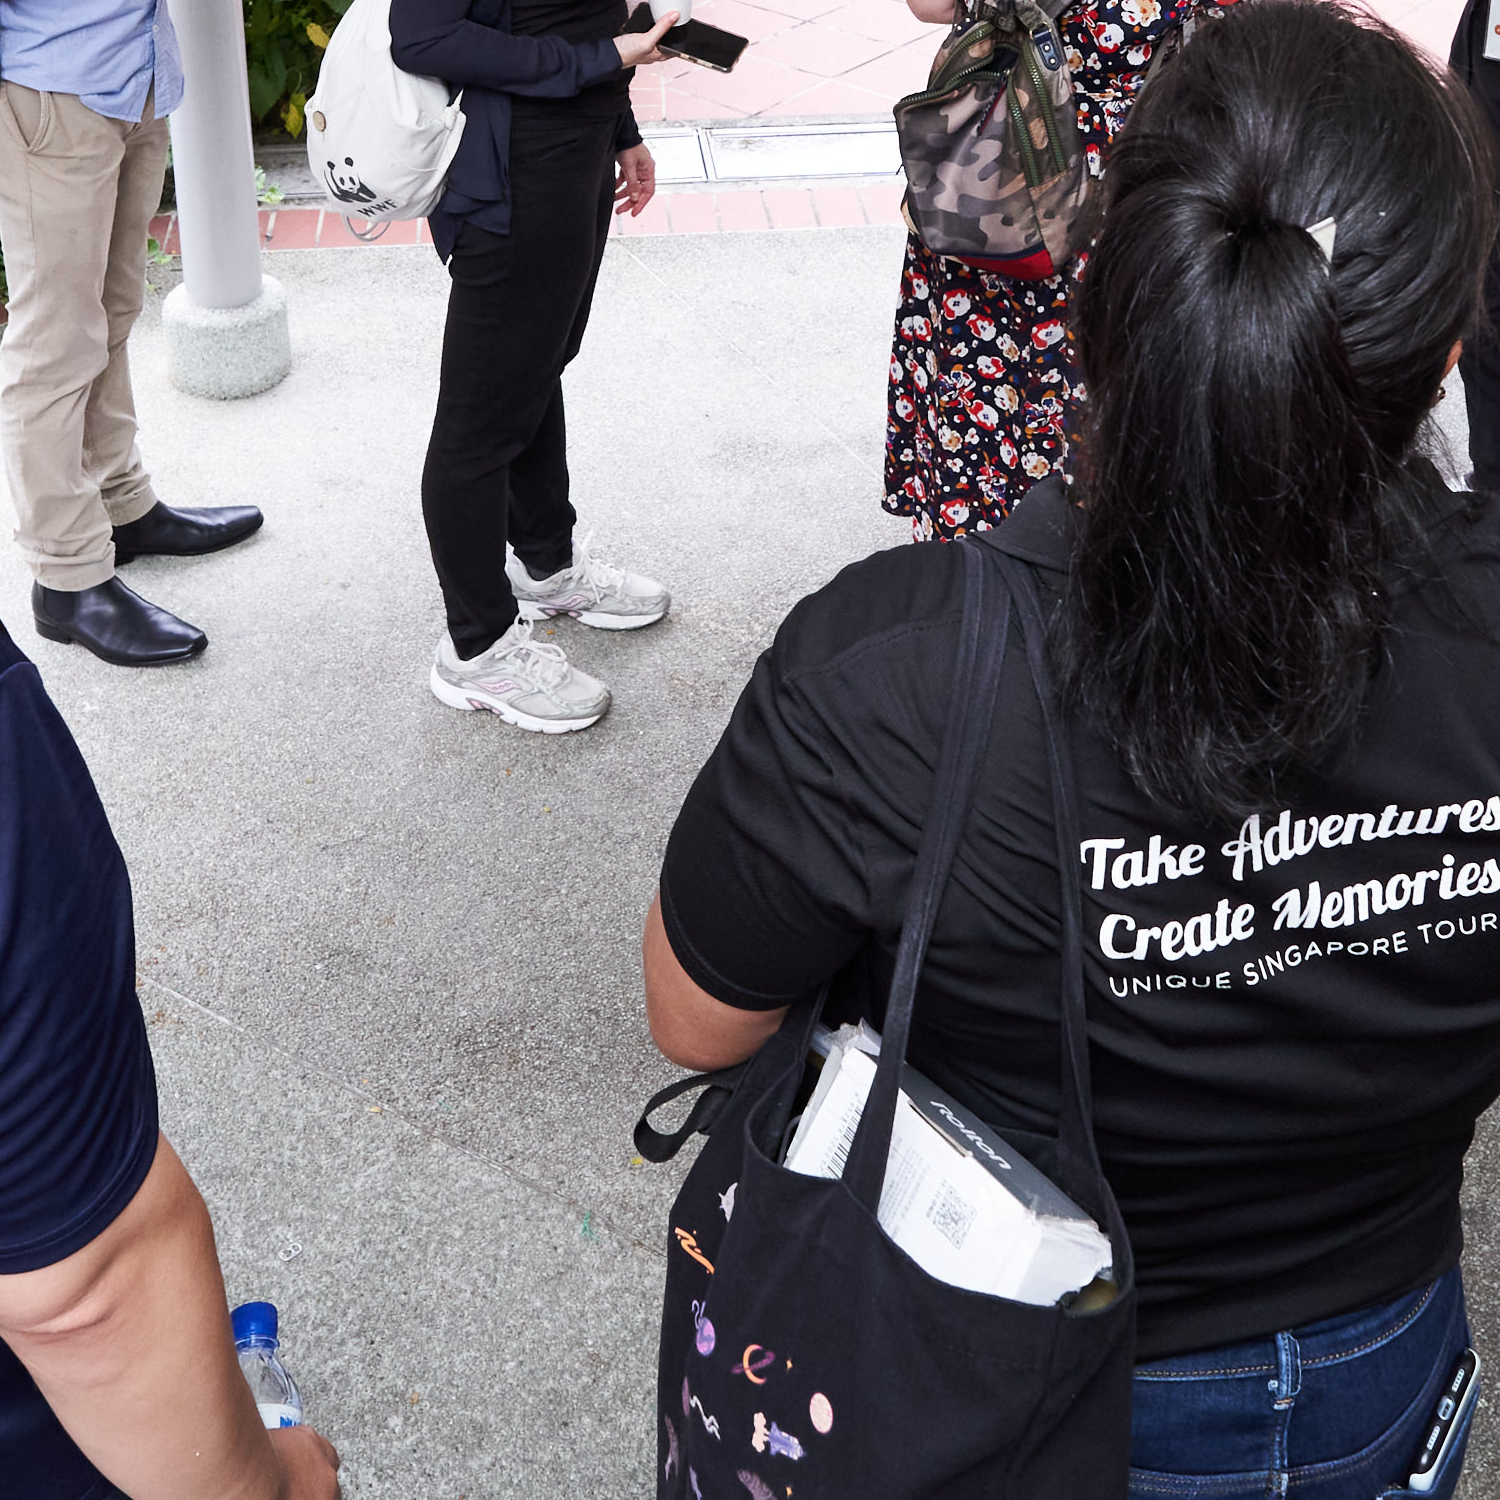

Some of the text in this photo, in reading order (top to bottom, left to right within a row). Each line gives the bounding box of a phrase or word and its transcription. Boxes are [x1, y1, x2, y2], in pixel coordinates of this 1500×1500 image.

[356, 199, 398, 218] WWF
[1079, 834, 1206, 890] Take
[1099, 898, 1255, 962] Create
[1108, 971, 1232, 998] UNIQUE
[1243, 930, 1409, 986] SINGAPORE
